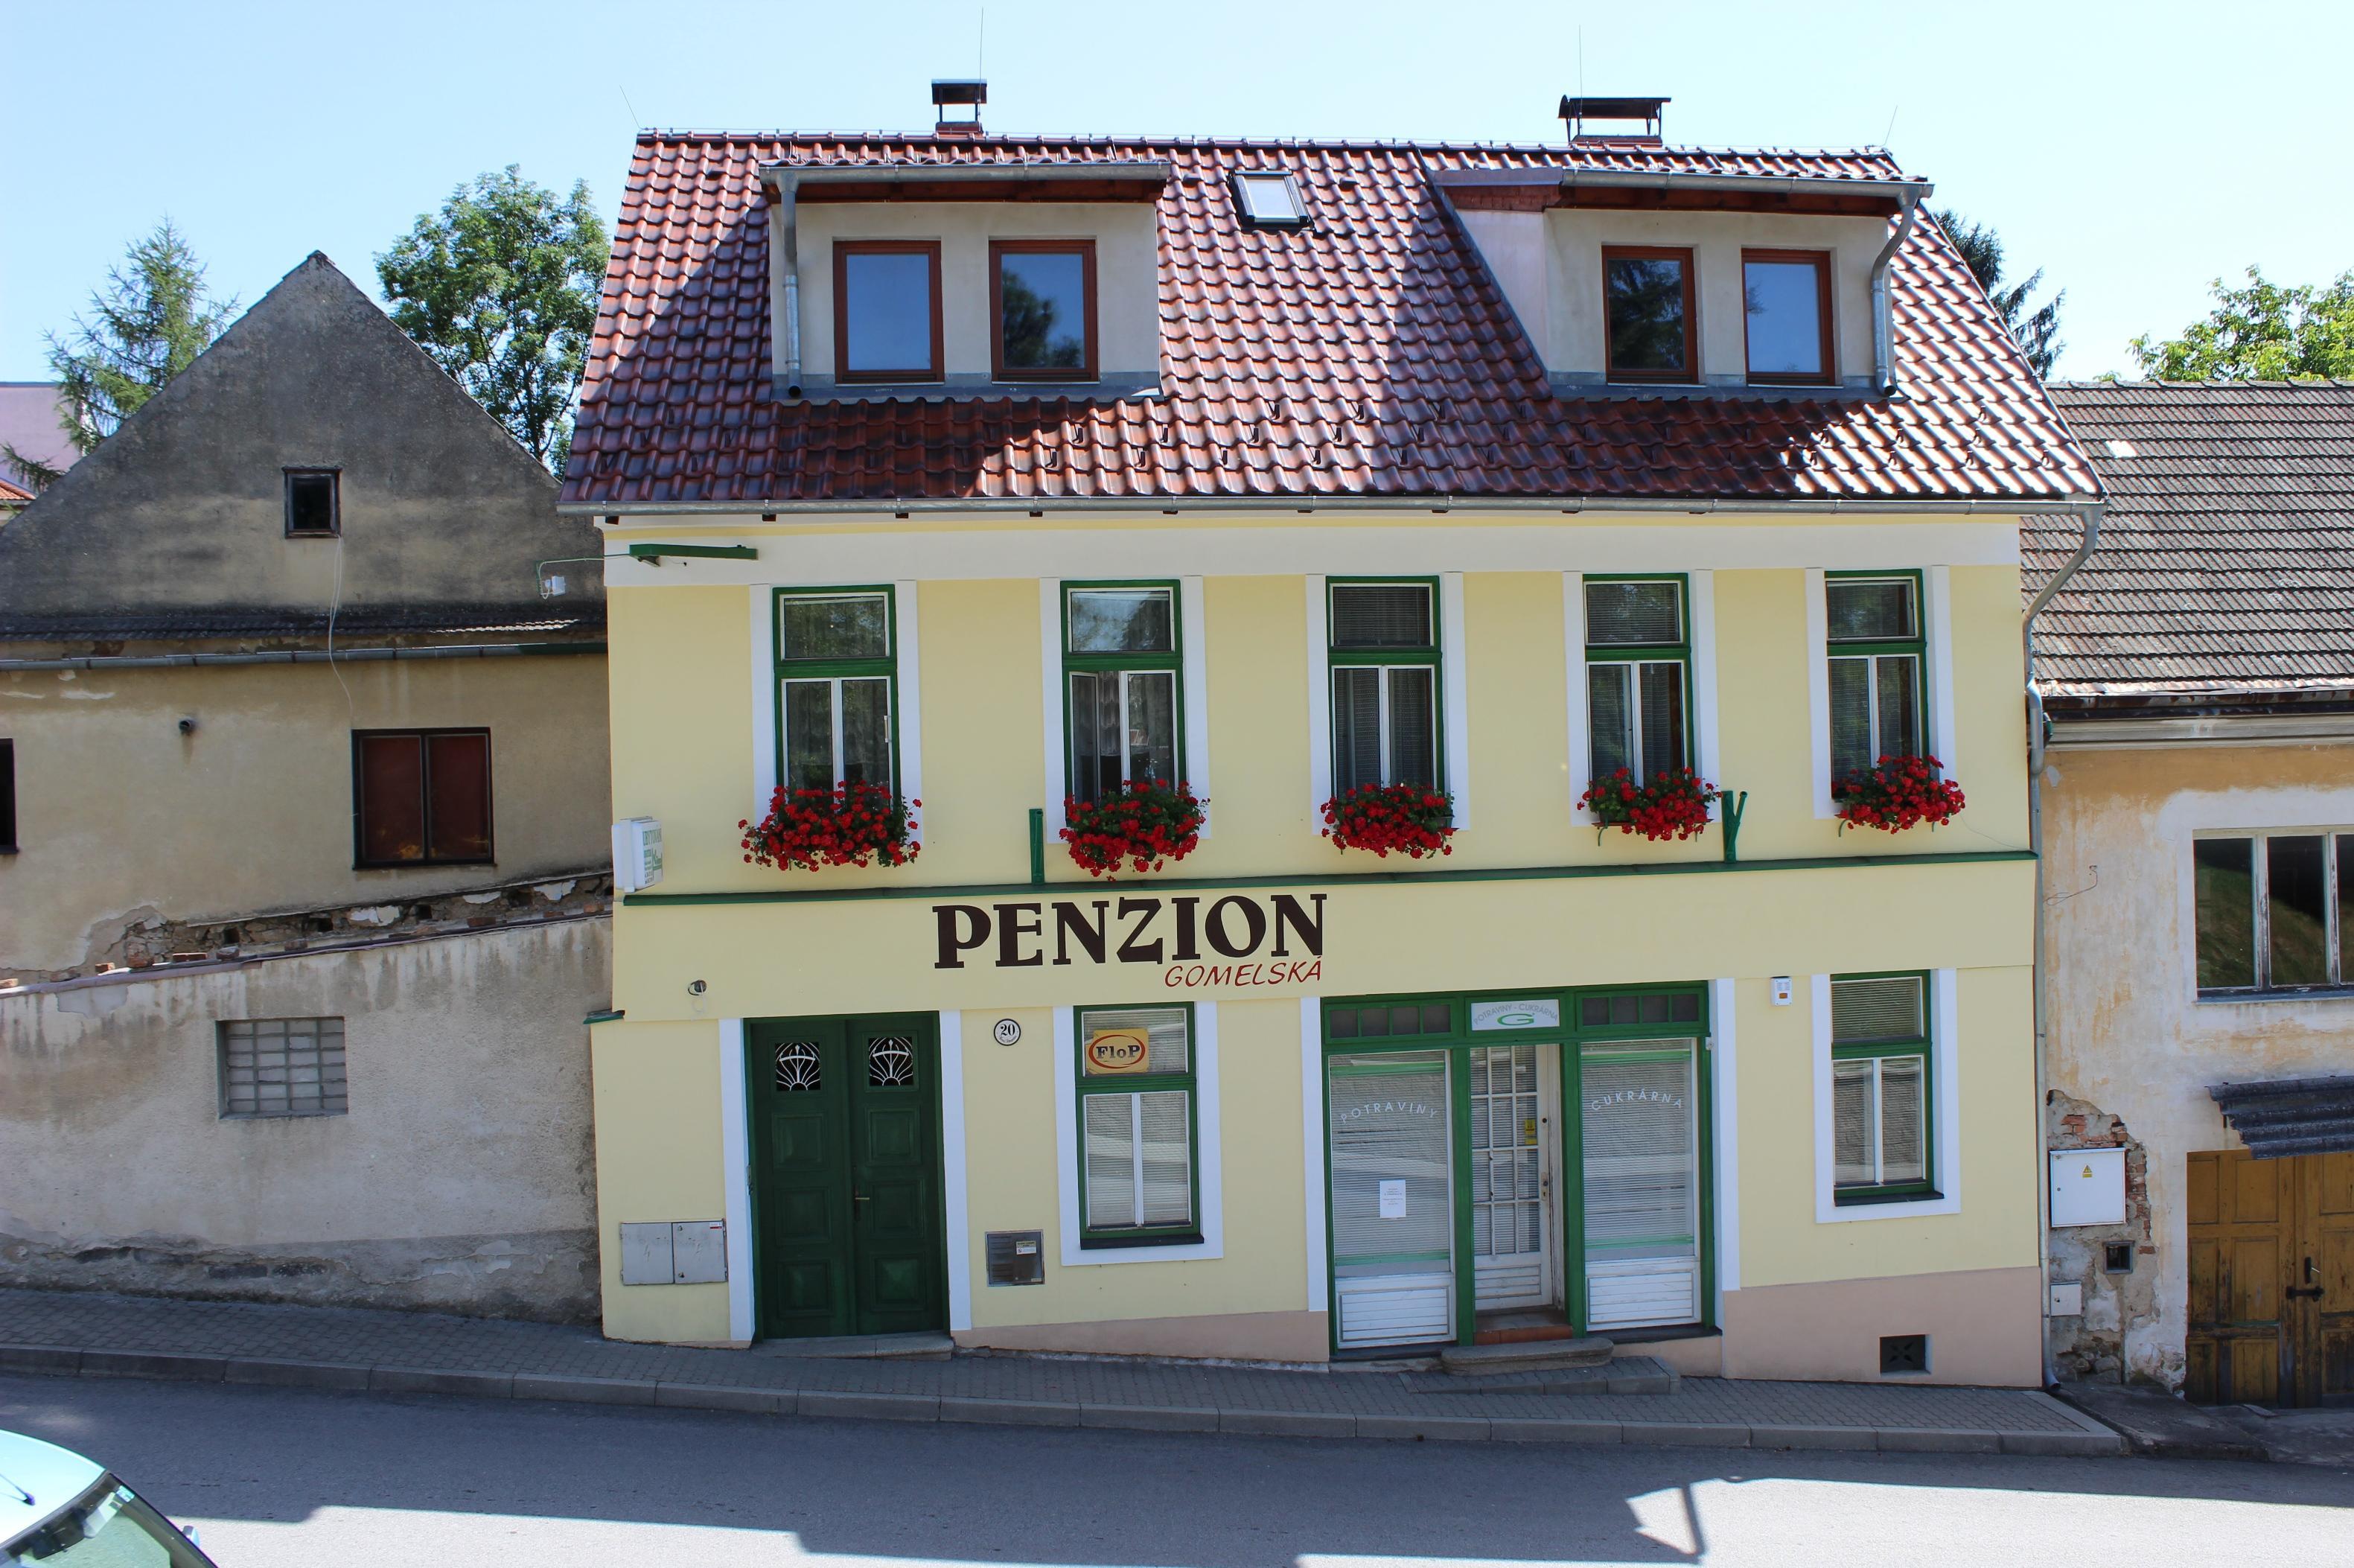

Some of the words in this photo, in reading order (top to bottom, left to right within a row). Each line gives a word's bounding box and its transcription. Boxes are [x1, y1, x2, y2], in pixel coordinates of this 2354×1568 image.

[932, 893, 1327, 969] PENZION
[1164, 956, 1321, 987] GOMELSKÁ
[1473, 1004, 1513, 1024] POTRAVINY
[1519, 1004, 1557, 1021] CUKRÁRNA
[1000, 1023, 1015, 1036] 20
[1096, 1045, 1141, 1059] FloP
[1592, 1088, 1682, 1110] CUKRÁRNA
[1341, 1101, 1438, 1125] POTRAVINY
